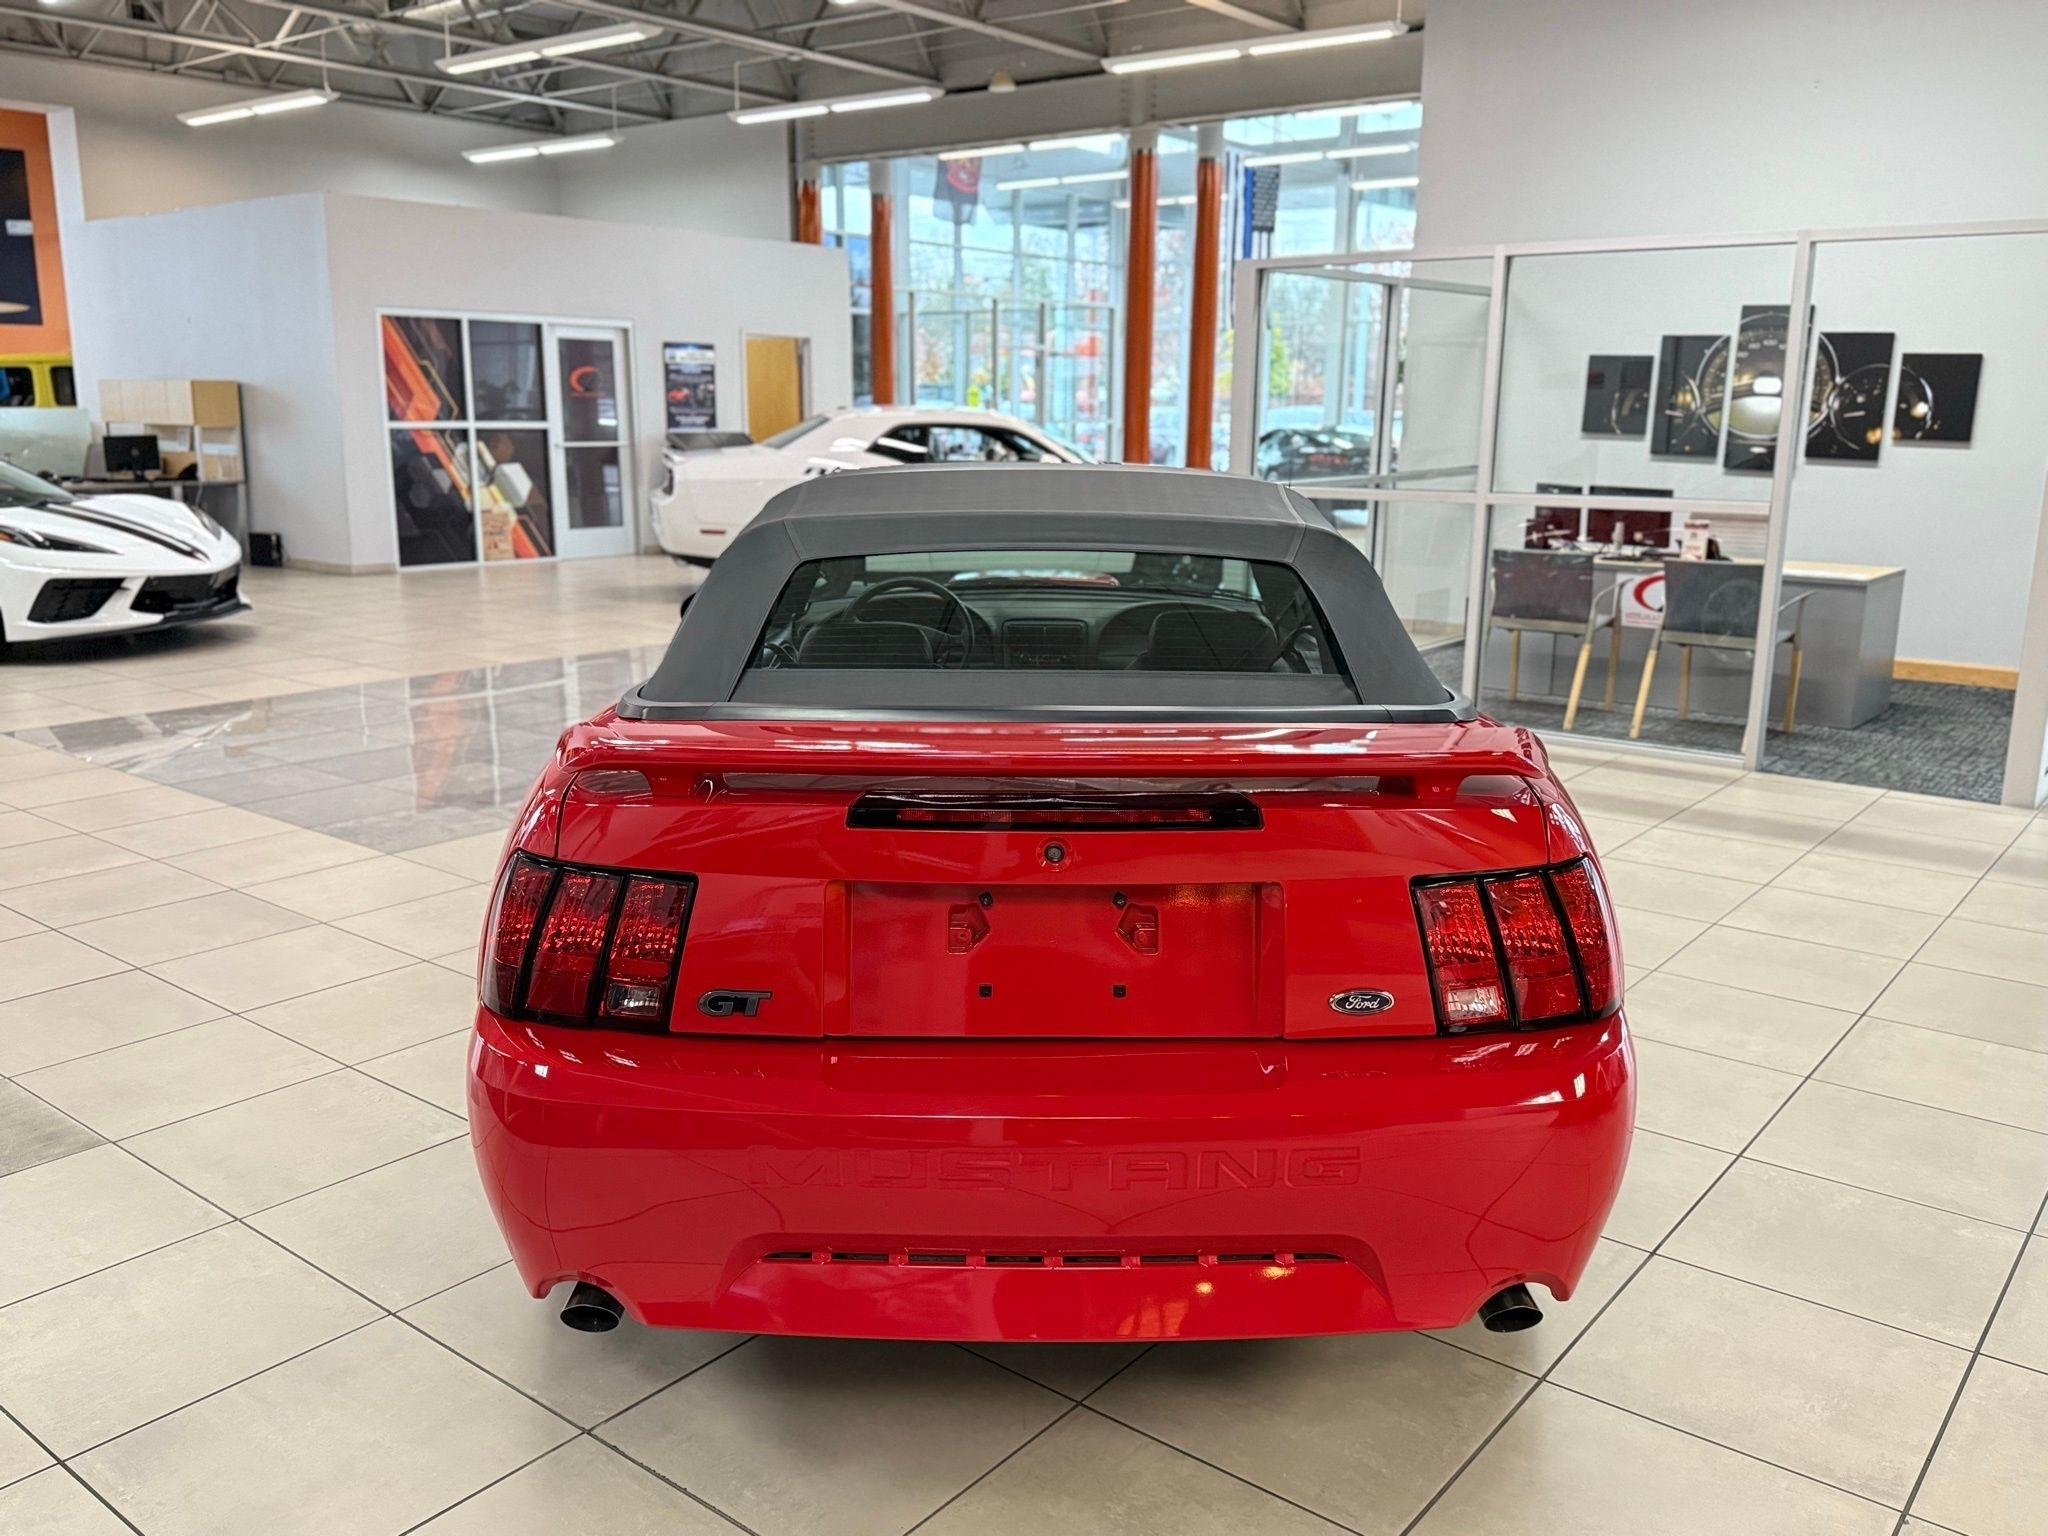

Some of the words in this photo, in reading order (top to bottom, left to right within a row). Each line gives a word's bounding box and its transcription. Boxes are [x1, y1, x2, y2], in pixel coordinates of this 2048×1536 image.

[698, 990, 771, 1017] GT
[1345, 995, 1380, 1009] Ford
[748, 1145, 1361, 1191] MUSTANG
